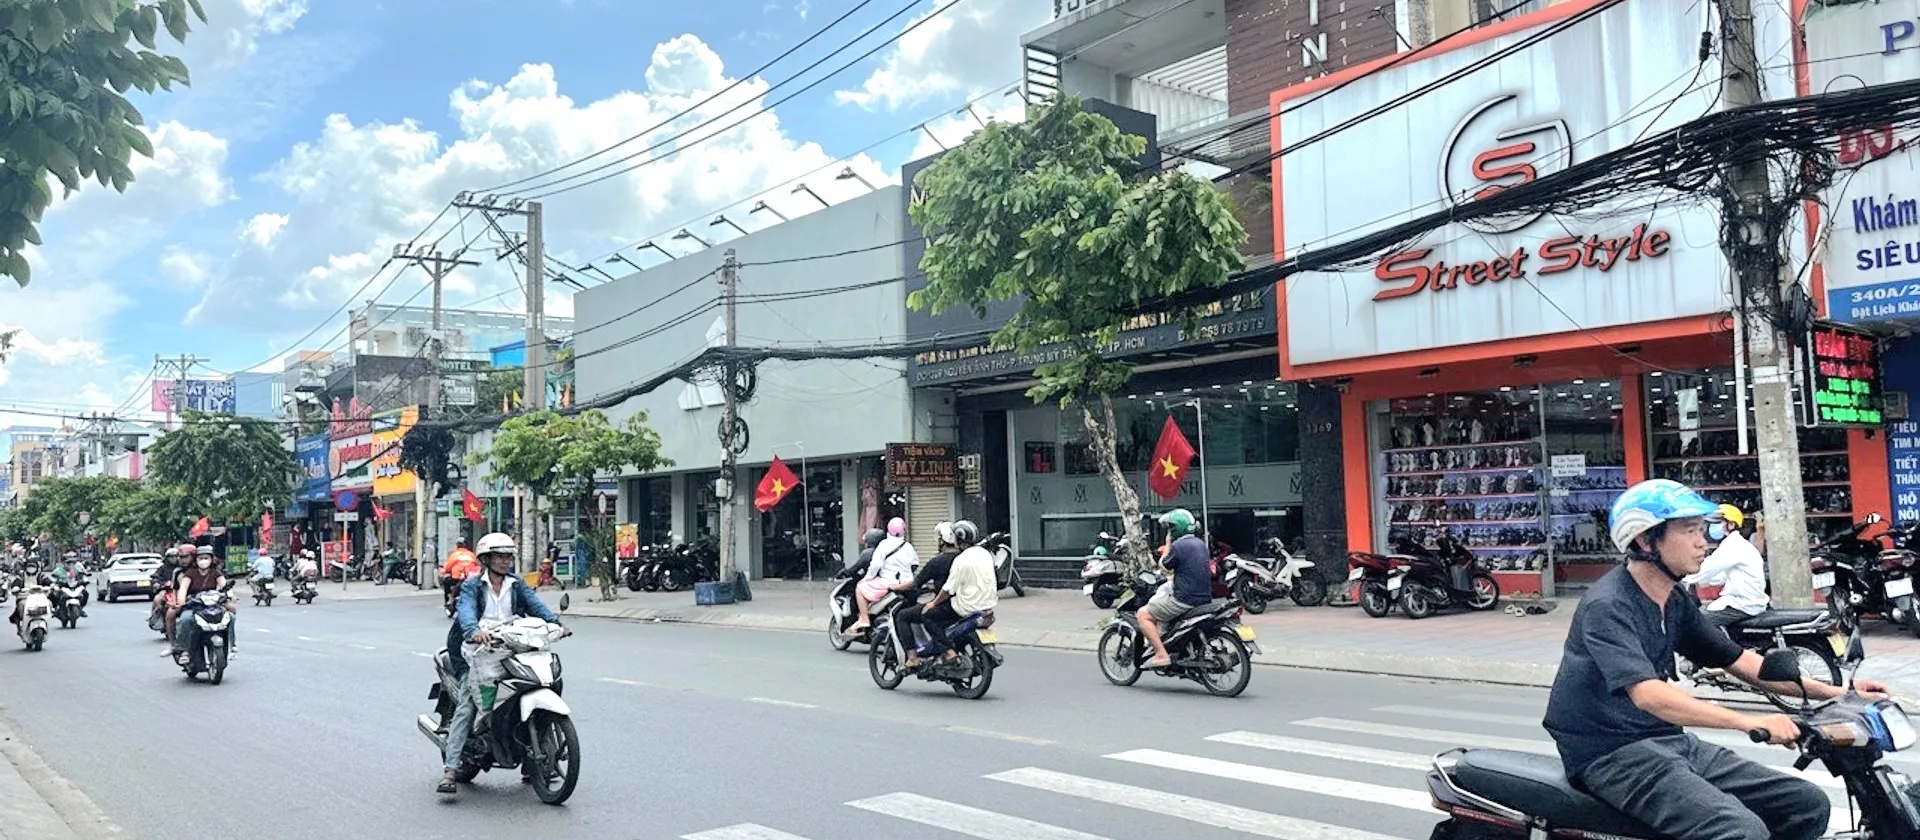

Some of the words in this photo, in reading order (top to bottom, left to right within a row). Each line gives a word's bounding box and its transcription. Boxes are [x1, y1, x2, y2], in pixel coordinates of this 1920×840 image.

[1852, 193, 1918, 234] Khám
[1375, 246, 1529, 301] Street
[1537, 222, 1672, 275] Style
[1856, 240, 1920, 271] SIÊU
[1124, 337, 1146, 350] HCM
